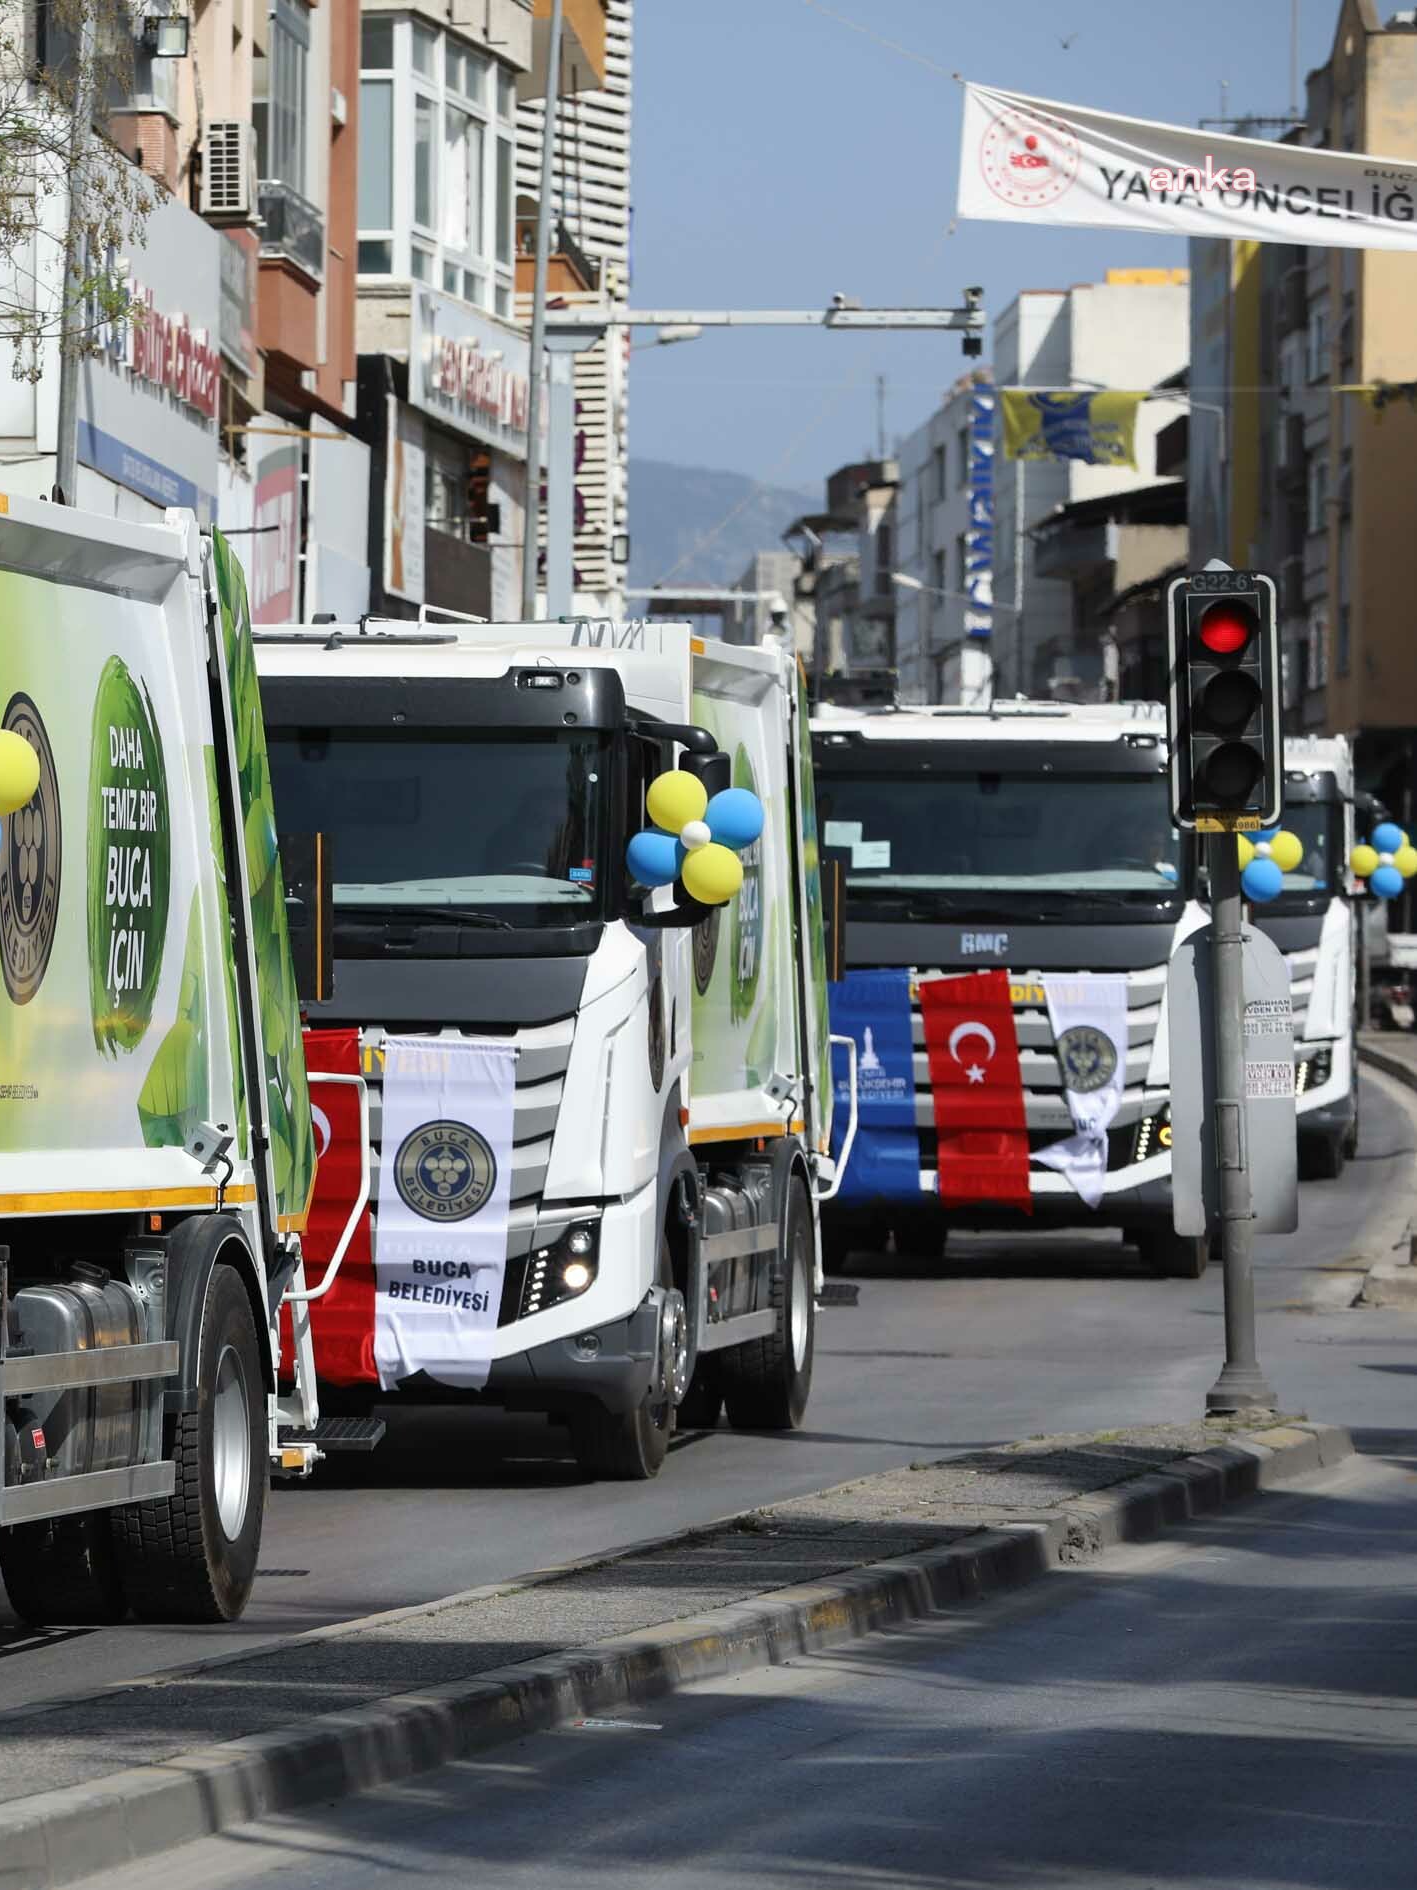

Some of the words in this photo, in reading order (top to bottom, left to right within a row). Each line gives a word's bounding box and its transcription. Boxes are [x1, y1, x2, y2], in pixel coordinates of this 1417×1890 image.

[1191, 574, 1248, 591] G22-6
[109, 726, 144, 770] DAHA
[101, 778, 136, 832] TEMİZ
[139, 780, 158, 832] BİR
[105, 846, 152, 907] BUCA
[107, 913, 145, 1008] İÇİN
[422, 1132, 470, 1149] BUCA
[404, 1175, 484, 1212] BELEDİYESİ
[412, 1259, 472, 1279] BUCA
[388, 1281, 489, 1312] BELEDİYESİ
